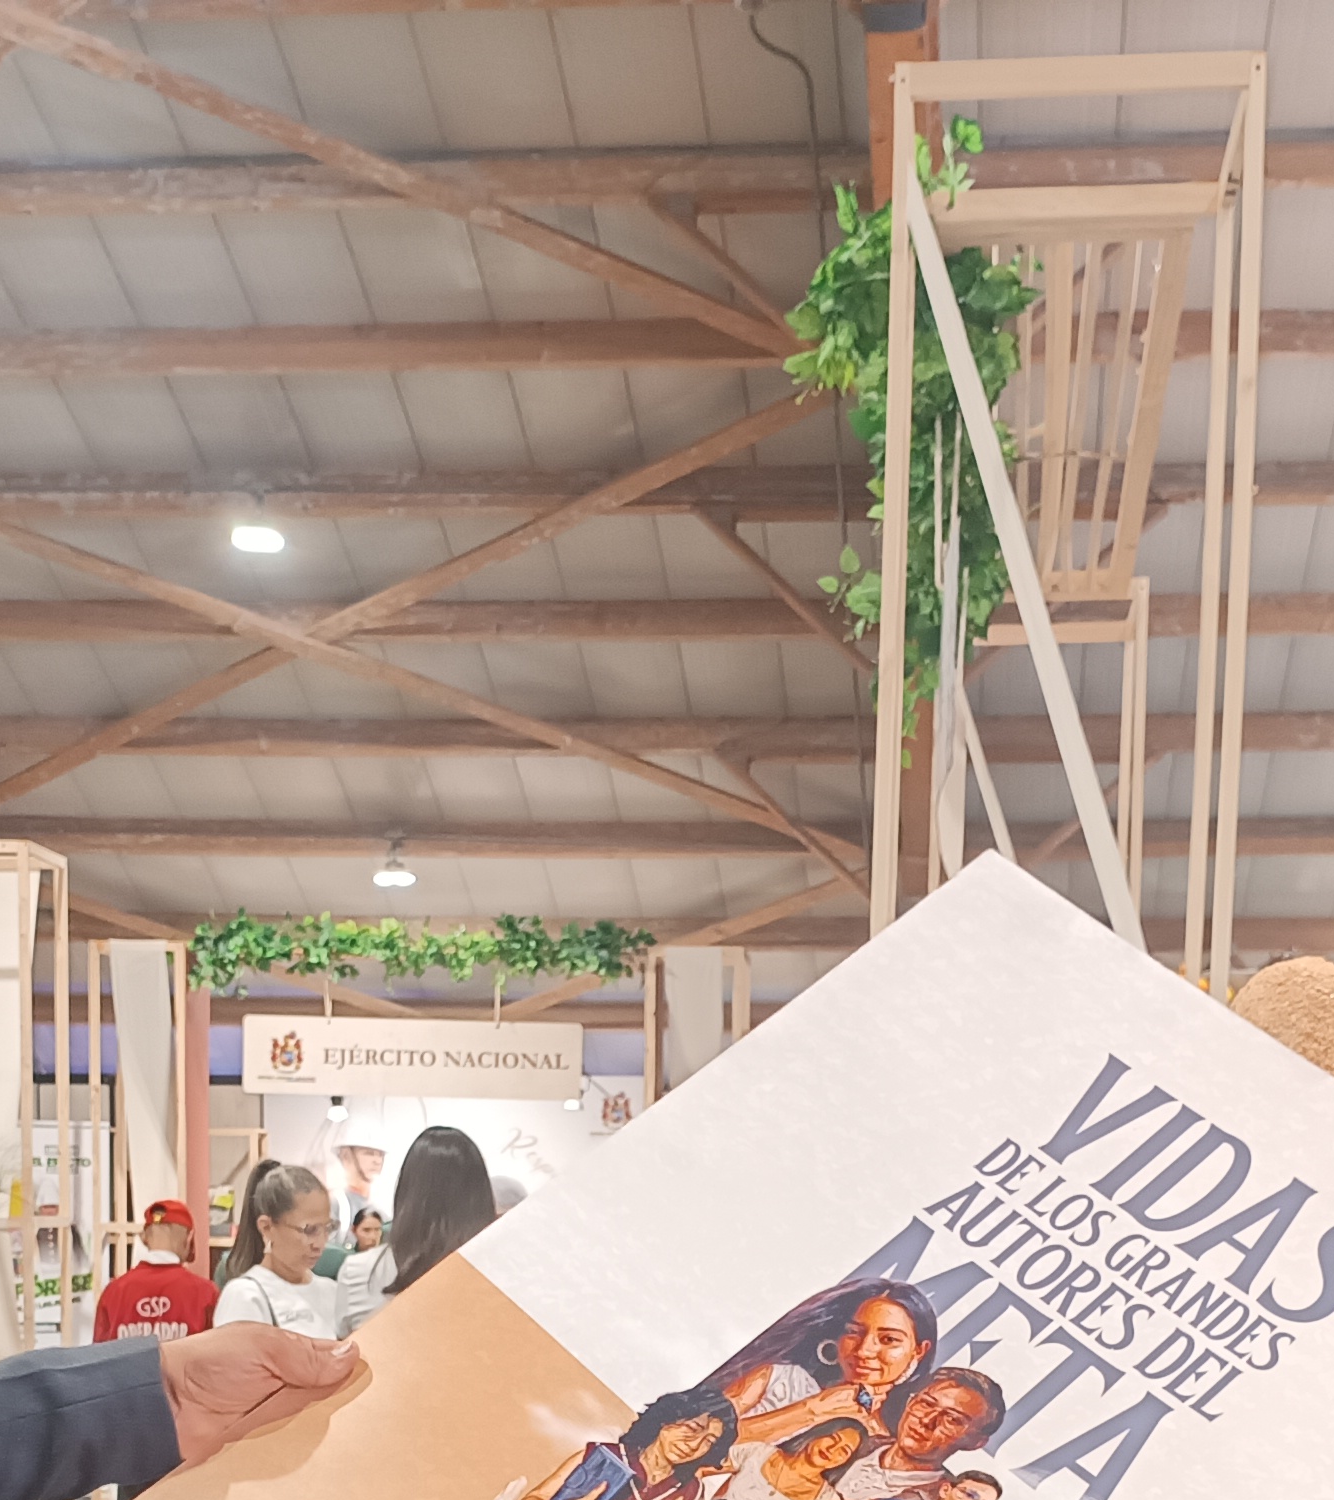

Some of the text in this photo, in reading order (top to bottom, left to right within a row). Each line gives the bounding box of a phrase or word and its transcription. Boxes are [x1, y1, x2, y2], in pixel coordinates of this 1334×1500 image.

[323, 1044, 569, 1070] EJÉRCITO NACIONAL
[136, 1296, 171, 1318] GSP
[923, 1181, 1244, 1422] AUTORES DEL
[973, 1138, 1296, 1371] DE LOS GRANDES
